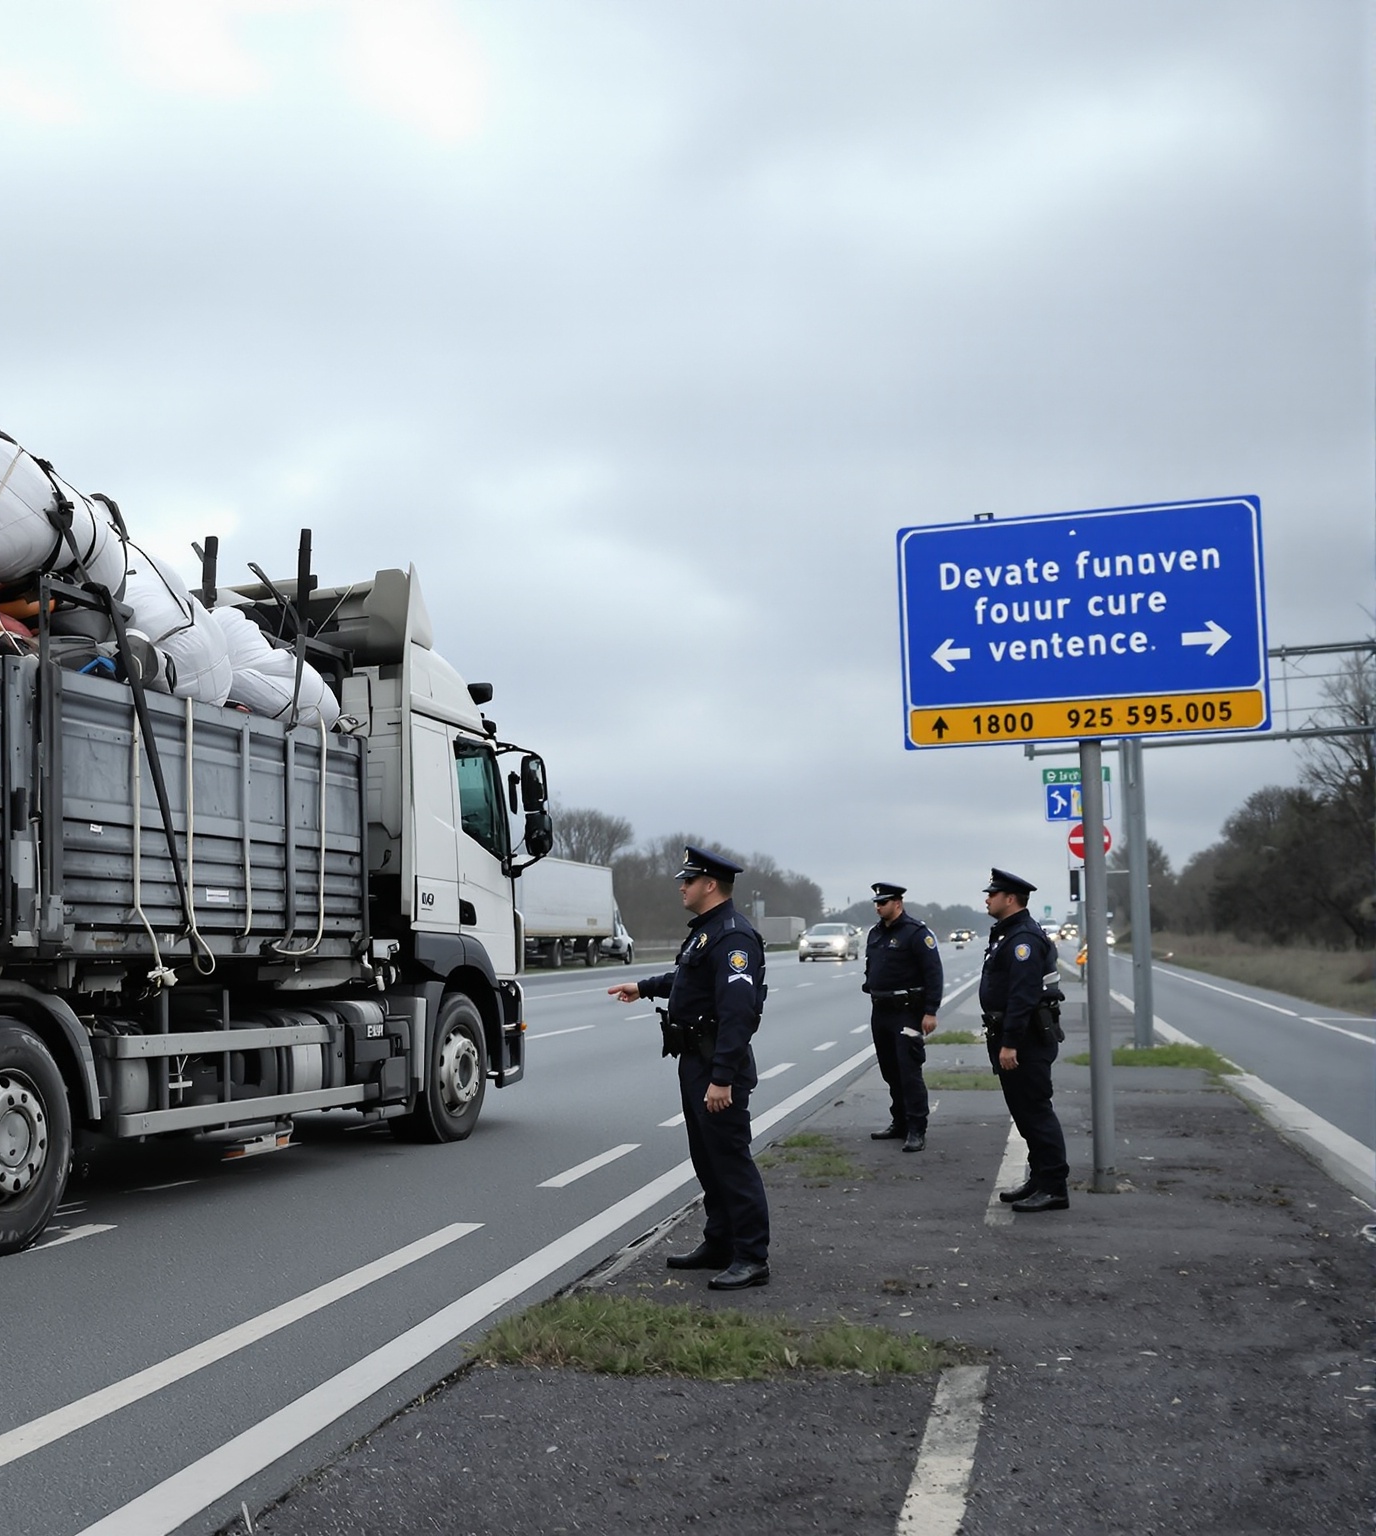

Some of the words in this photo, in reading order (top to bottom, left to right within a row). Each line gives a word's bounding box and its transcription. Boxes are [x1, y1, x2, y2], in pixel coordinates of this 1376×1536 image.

[939, 557, 1060, 591] Devate
[974, 596, 1072, 625] fouur
[1087, 591, 1167, 617] cure
[972, 712, 1034, 735] 1800
[1067, 707, 1114, 729] 925
[1126, 701, 1232, 726] 595.005
